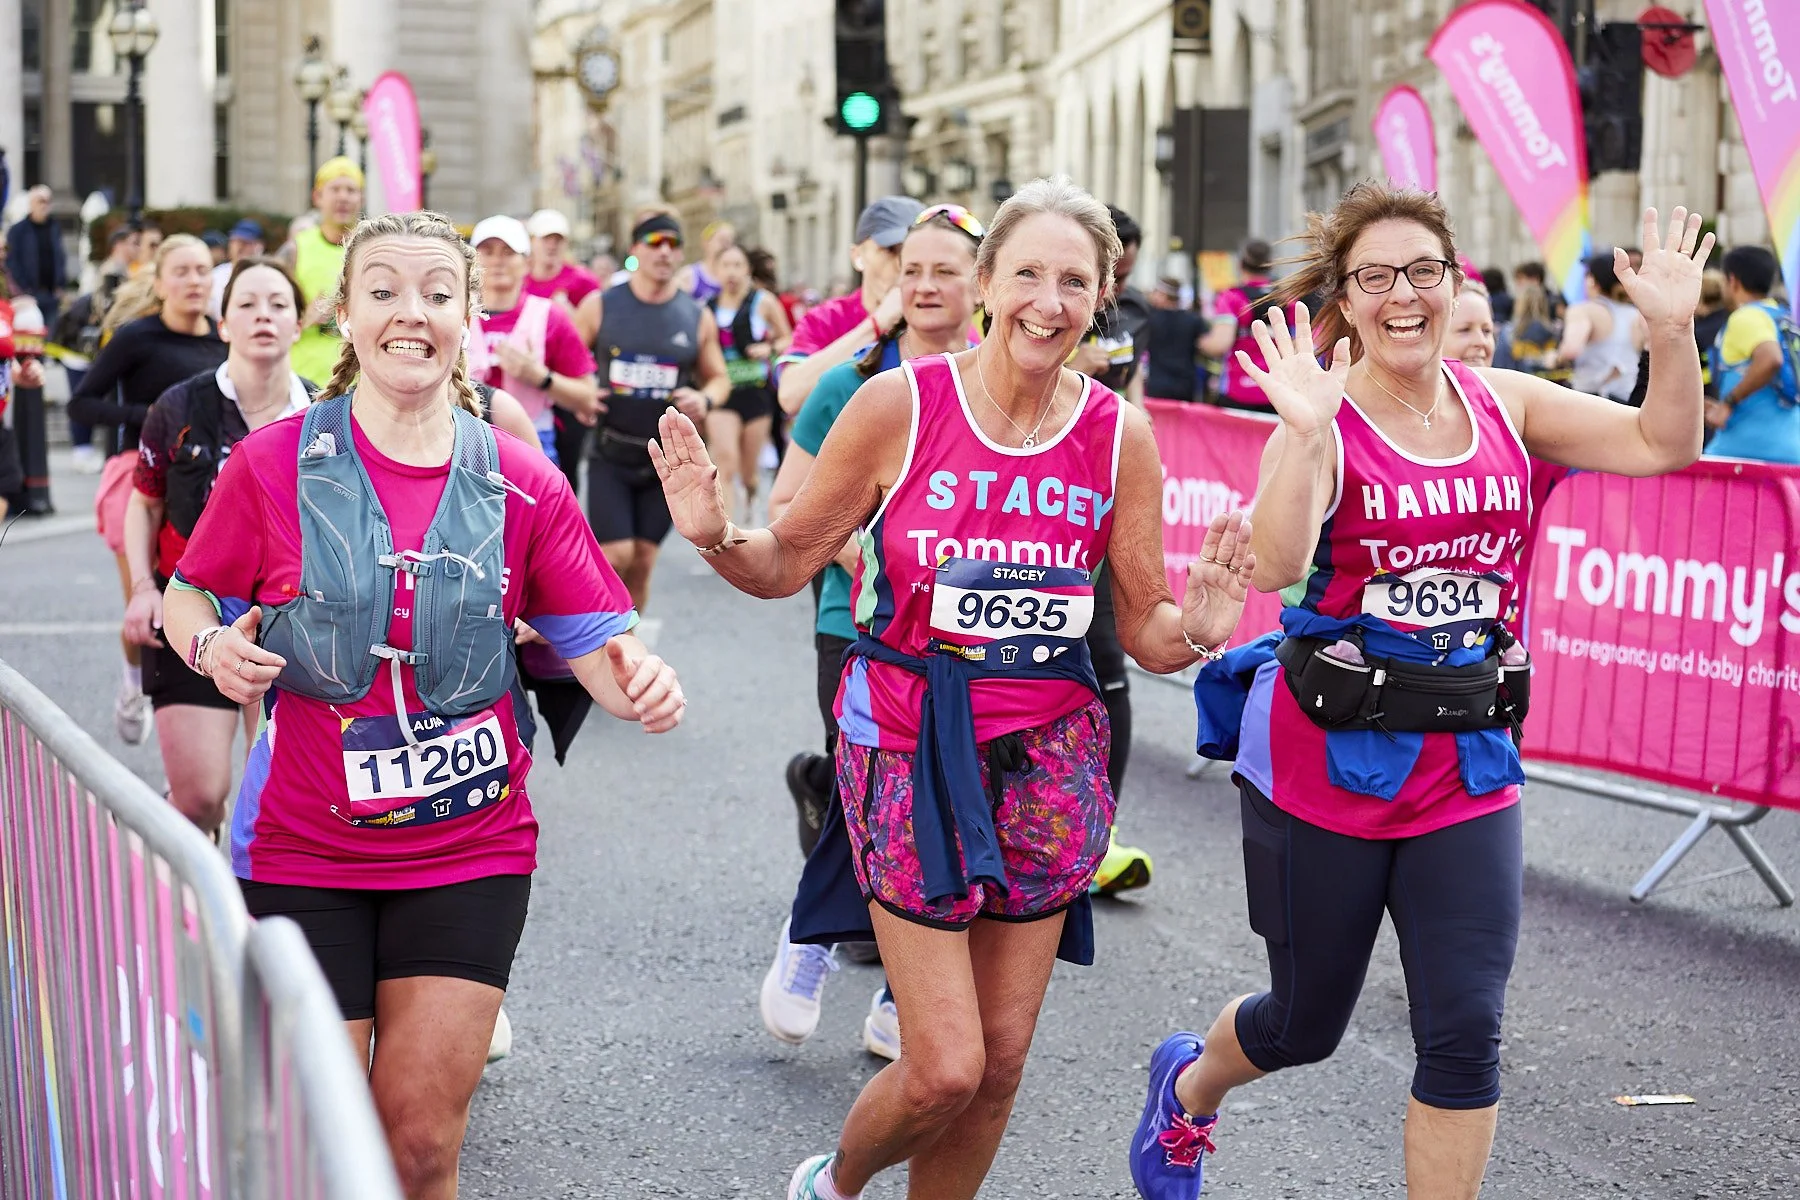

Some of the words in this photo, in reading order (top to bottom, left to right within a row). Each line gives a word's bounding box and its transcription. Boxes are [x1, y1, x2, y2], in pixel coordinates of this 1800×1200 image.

[333, 486, 357, 501] OSPREY
[926, 471, 1114, 530] STACEY
[1362, 476, 1521, 519] HANNAH
[993, 568, 1046, 581] STACEY
[1547, 526, 1800, 646] Tommy's
[957, 592, 1069, 631] 9635
[1387, 580, 1483, 617] 9634
[1541, 628, 1569, 653] The
[1570, 638, 1658, 674] pregnancy
[1660, 650, 1694, 674] and
[1698, 650, 1744, 687] baby
[1747, 661, 1800, 696] charit
[360, 727, 496, 793] 11260
